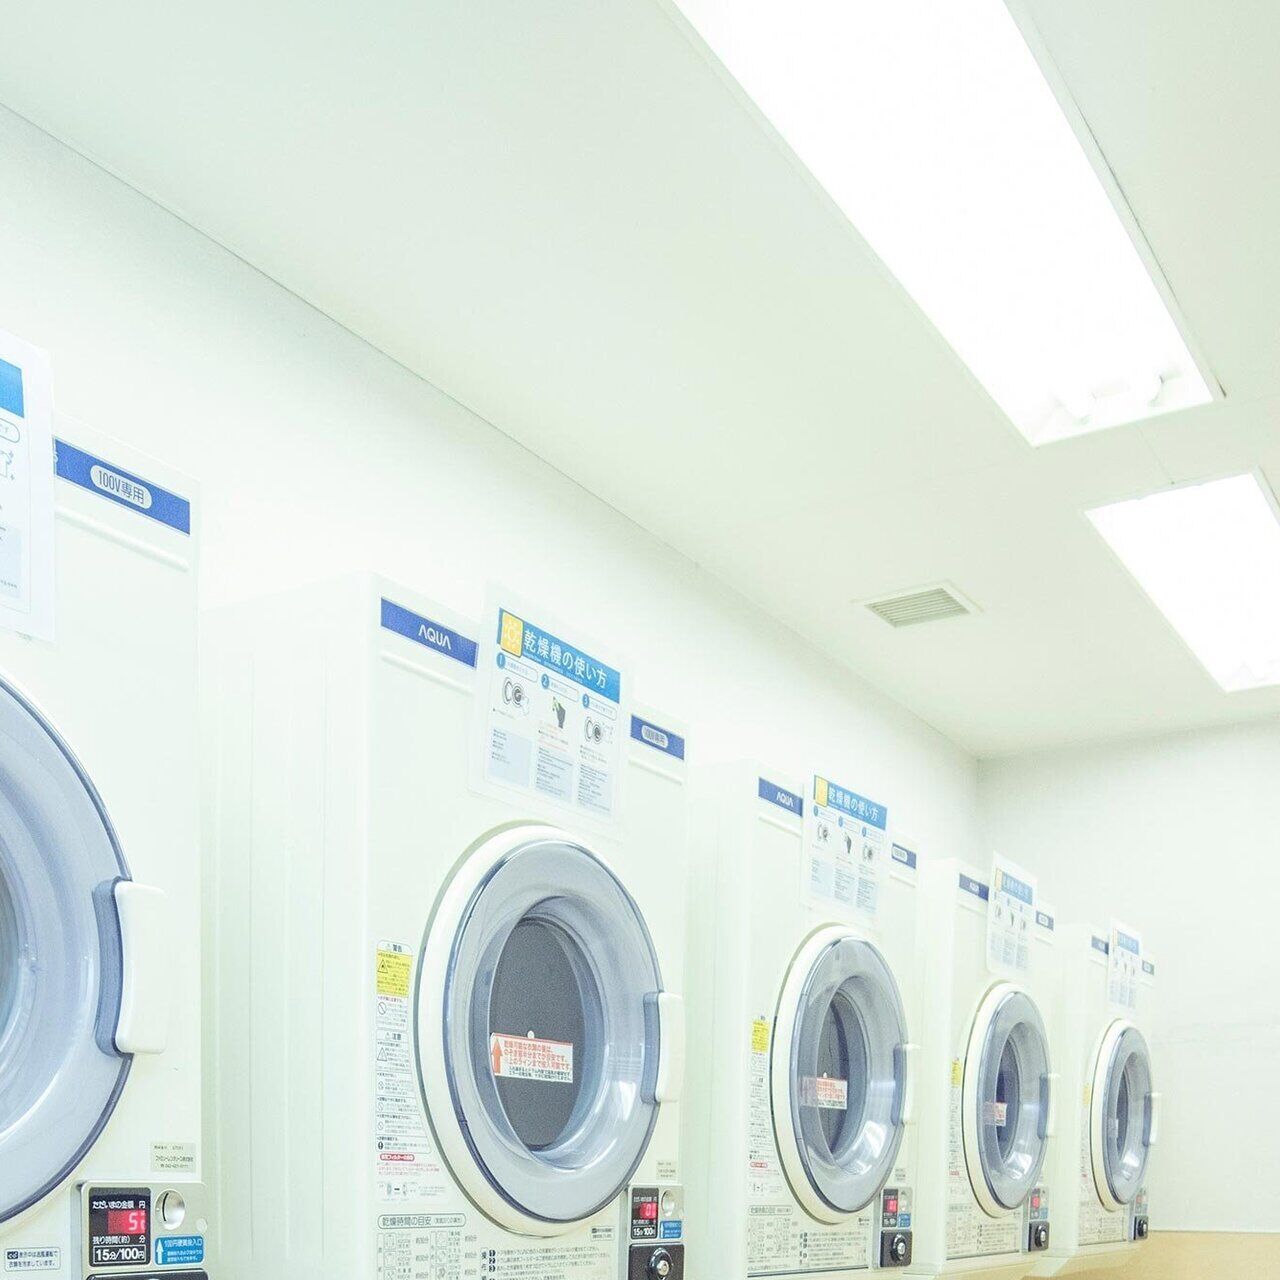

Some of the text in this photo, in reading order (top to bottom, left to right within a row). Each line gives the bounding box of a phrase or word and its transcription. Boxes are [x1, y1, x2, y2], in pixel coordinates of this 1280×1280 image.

[99, 470, 144, 504] 100V専用
[418, 625, 452, 651] AQUA
[523, 630, 608, 690] 乾燥機の使い方
[92, 1200, 146, 1210] ただいまの金額 円
[139, 1235, 146, 1244] 分
[95, 1246, 146, 1262] 15分/100円
